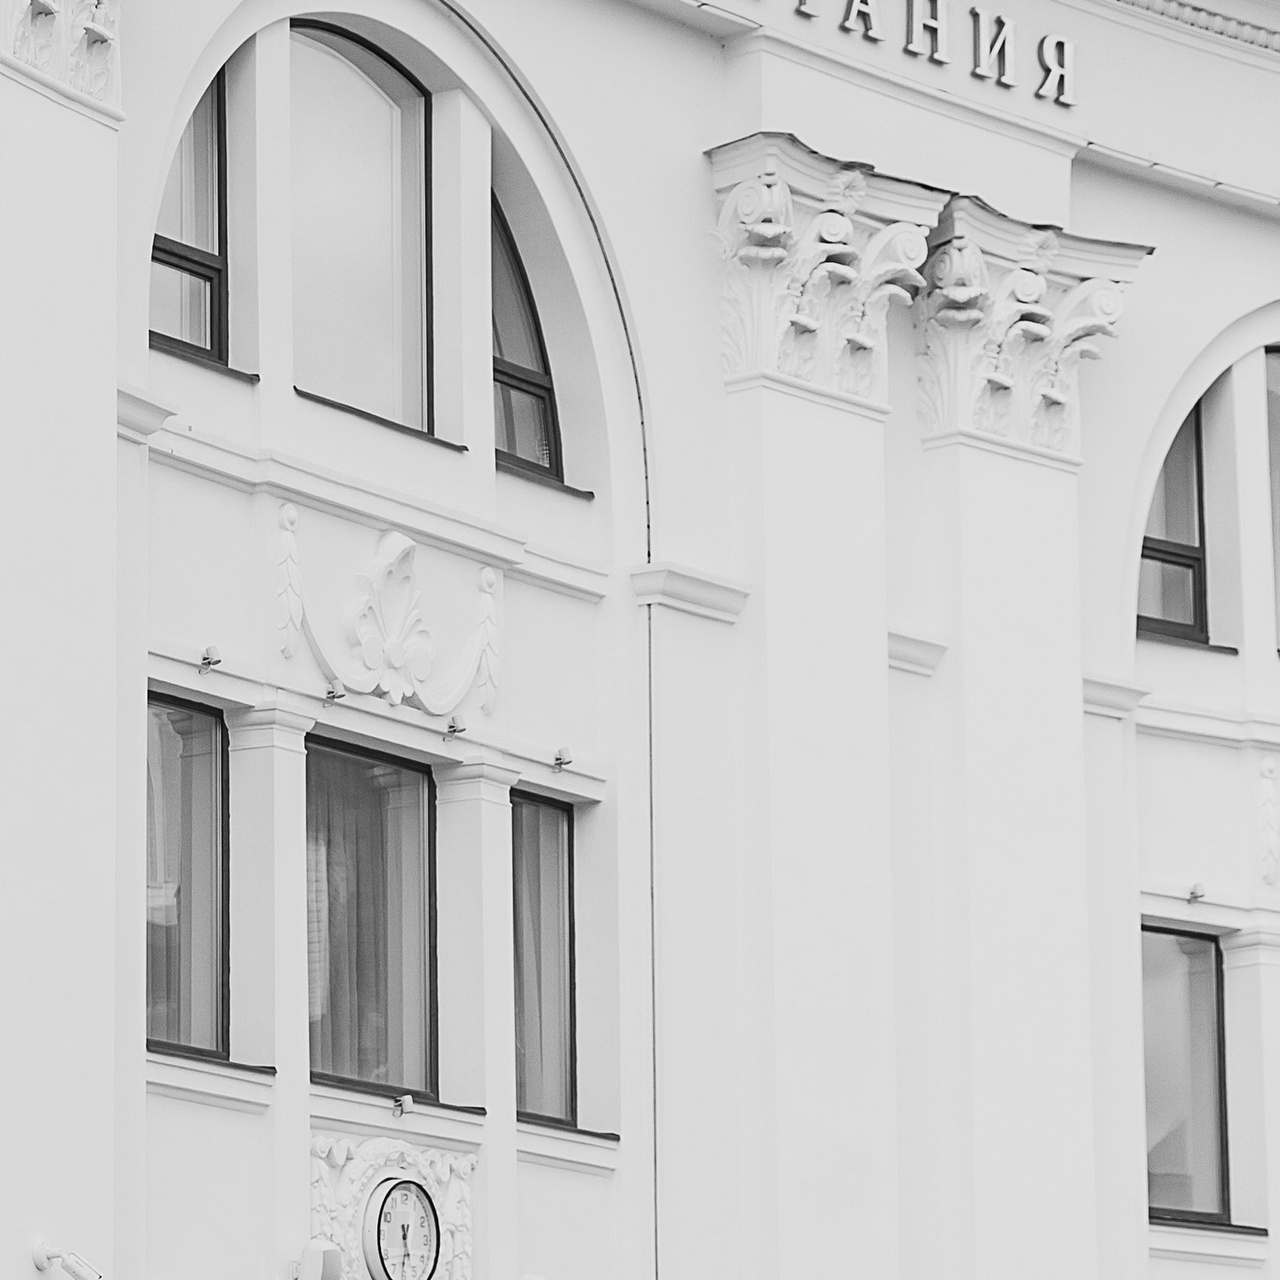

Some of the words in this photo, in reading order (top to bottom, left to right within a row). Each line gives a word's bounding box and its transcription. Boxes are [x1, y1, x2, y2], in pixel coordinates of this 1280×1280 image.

[401, 1193, 409, 1205] 12
[383, 1211, 392, 1223] 10
[420, 1216, 426, 1228] 2
[423, 1235, 429, 1246] 3
[384, 1248, 389, 1260] 8
[391, 1263, 397, 1275] 7
[412, 1266, 417, 1277] 5
